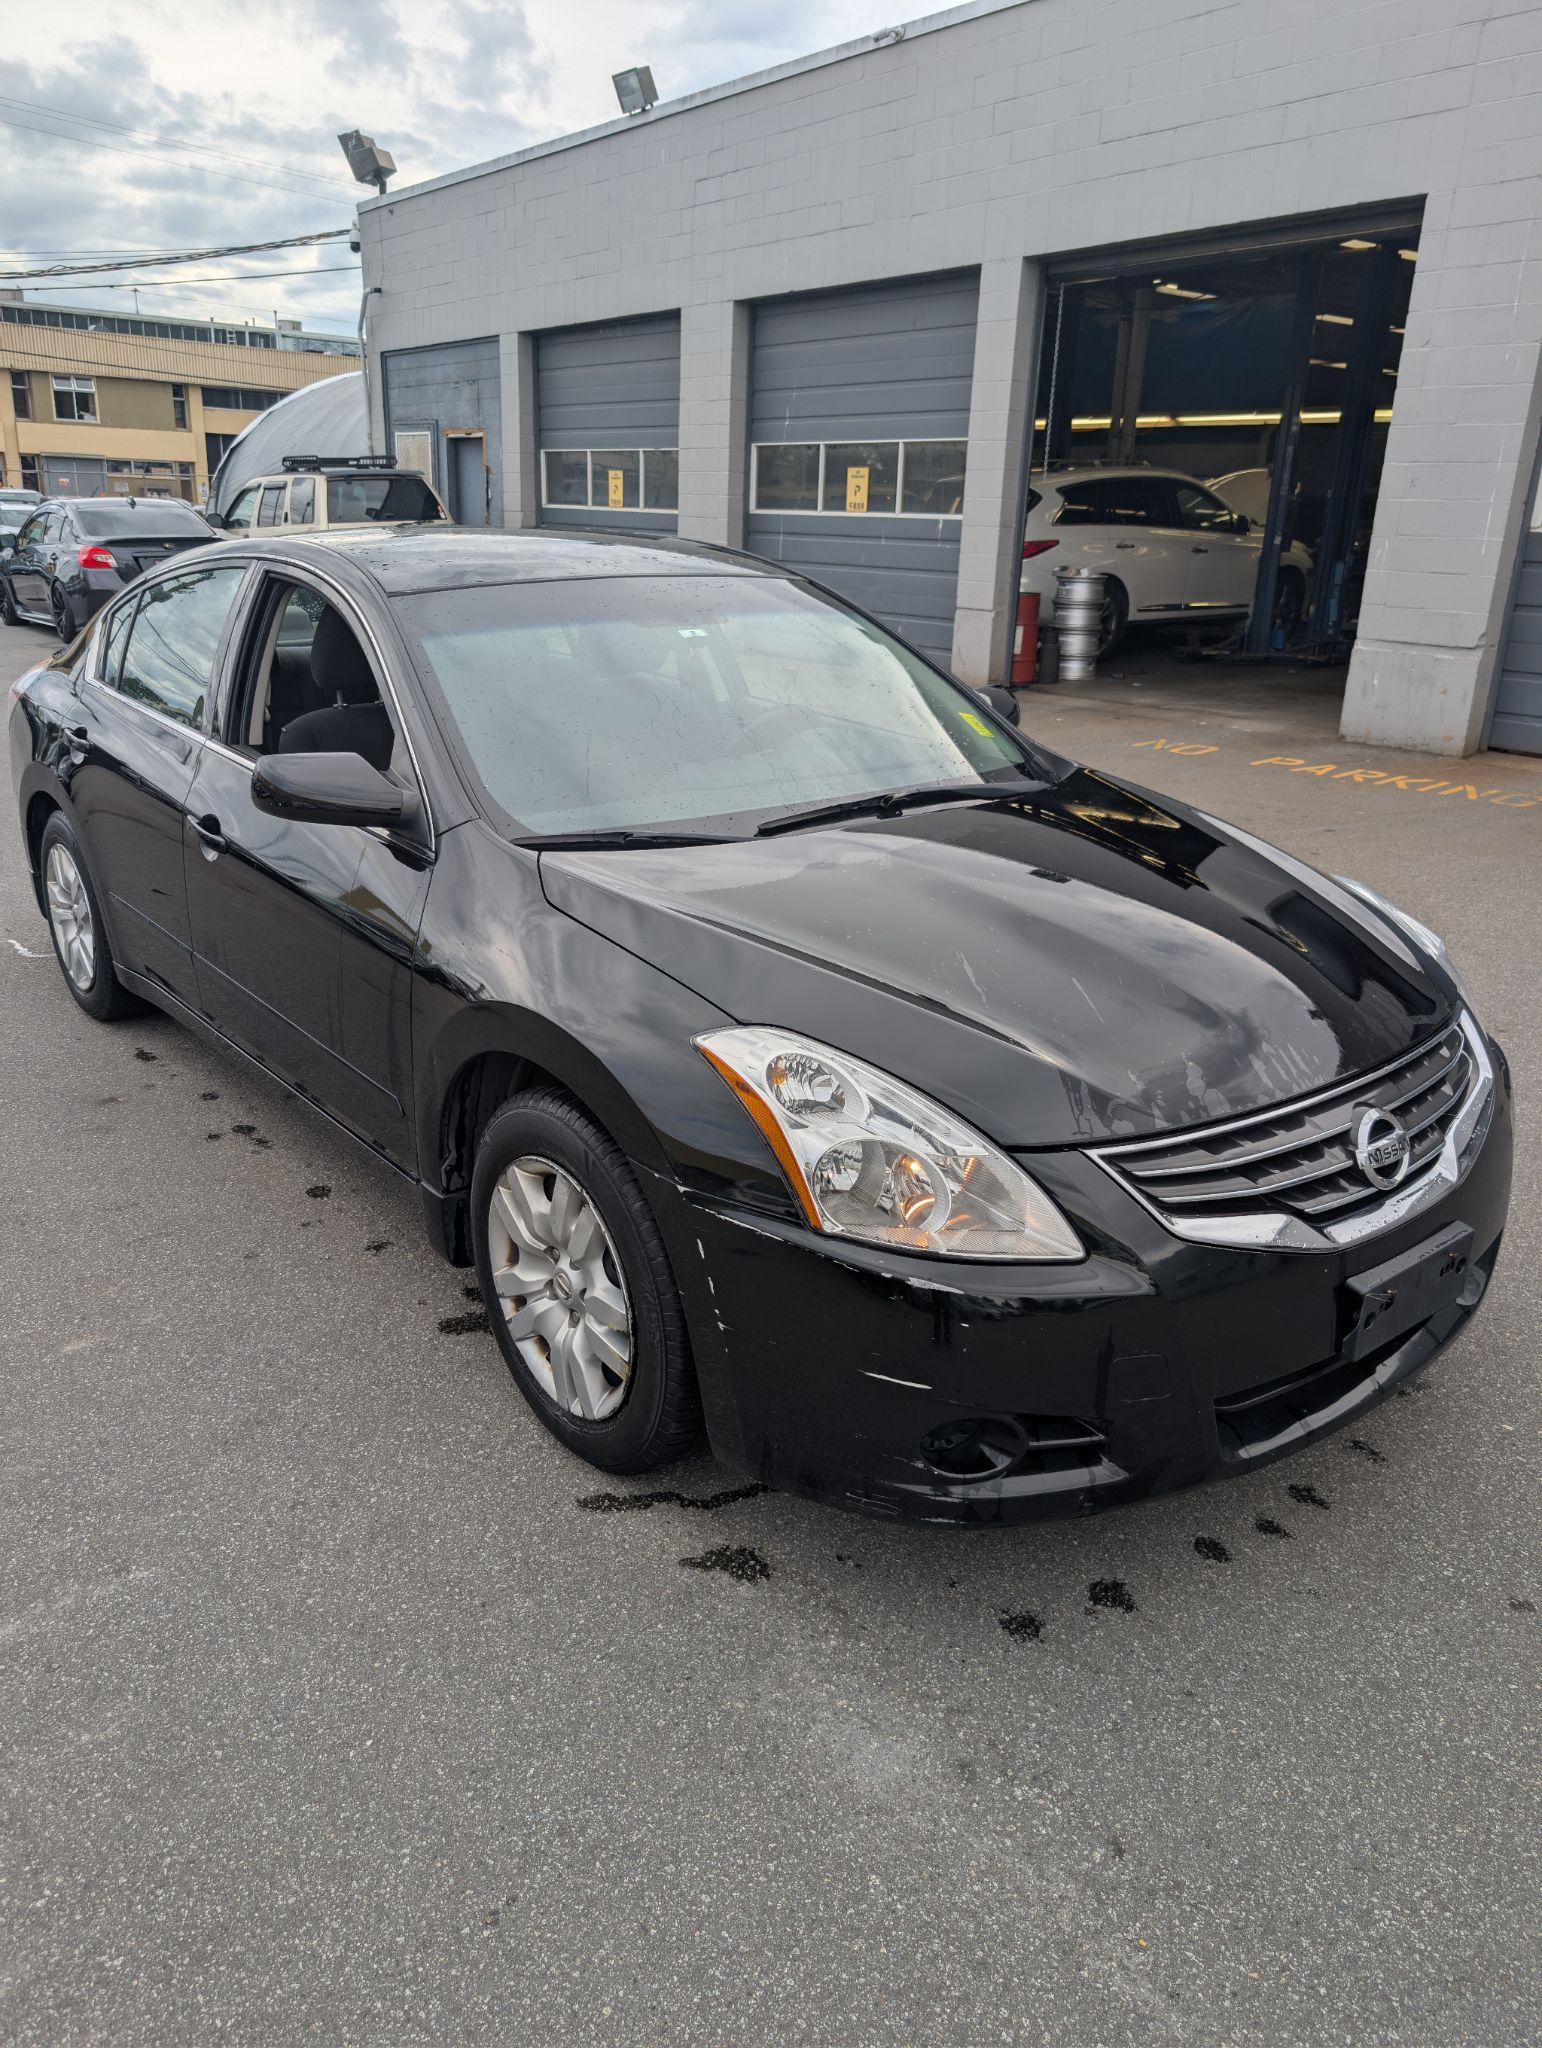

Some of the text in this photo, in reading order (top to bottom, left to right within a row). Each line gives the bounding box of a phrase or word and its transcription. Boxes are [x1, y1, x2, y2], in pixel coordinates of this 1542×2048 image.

[1131, 739, 1542, 807] NO PARKING
[1367, 1137, 1410, 1166] NISSAN
